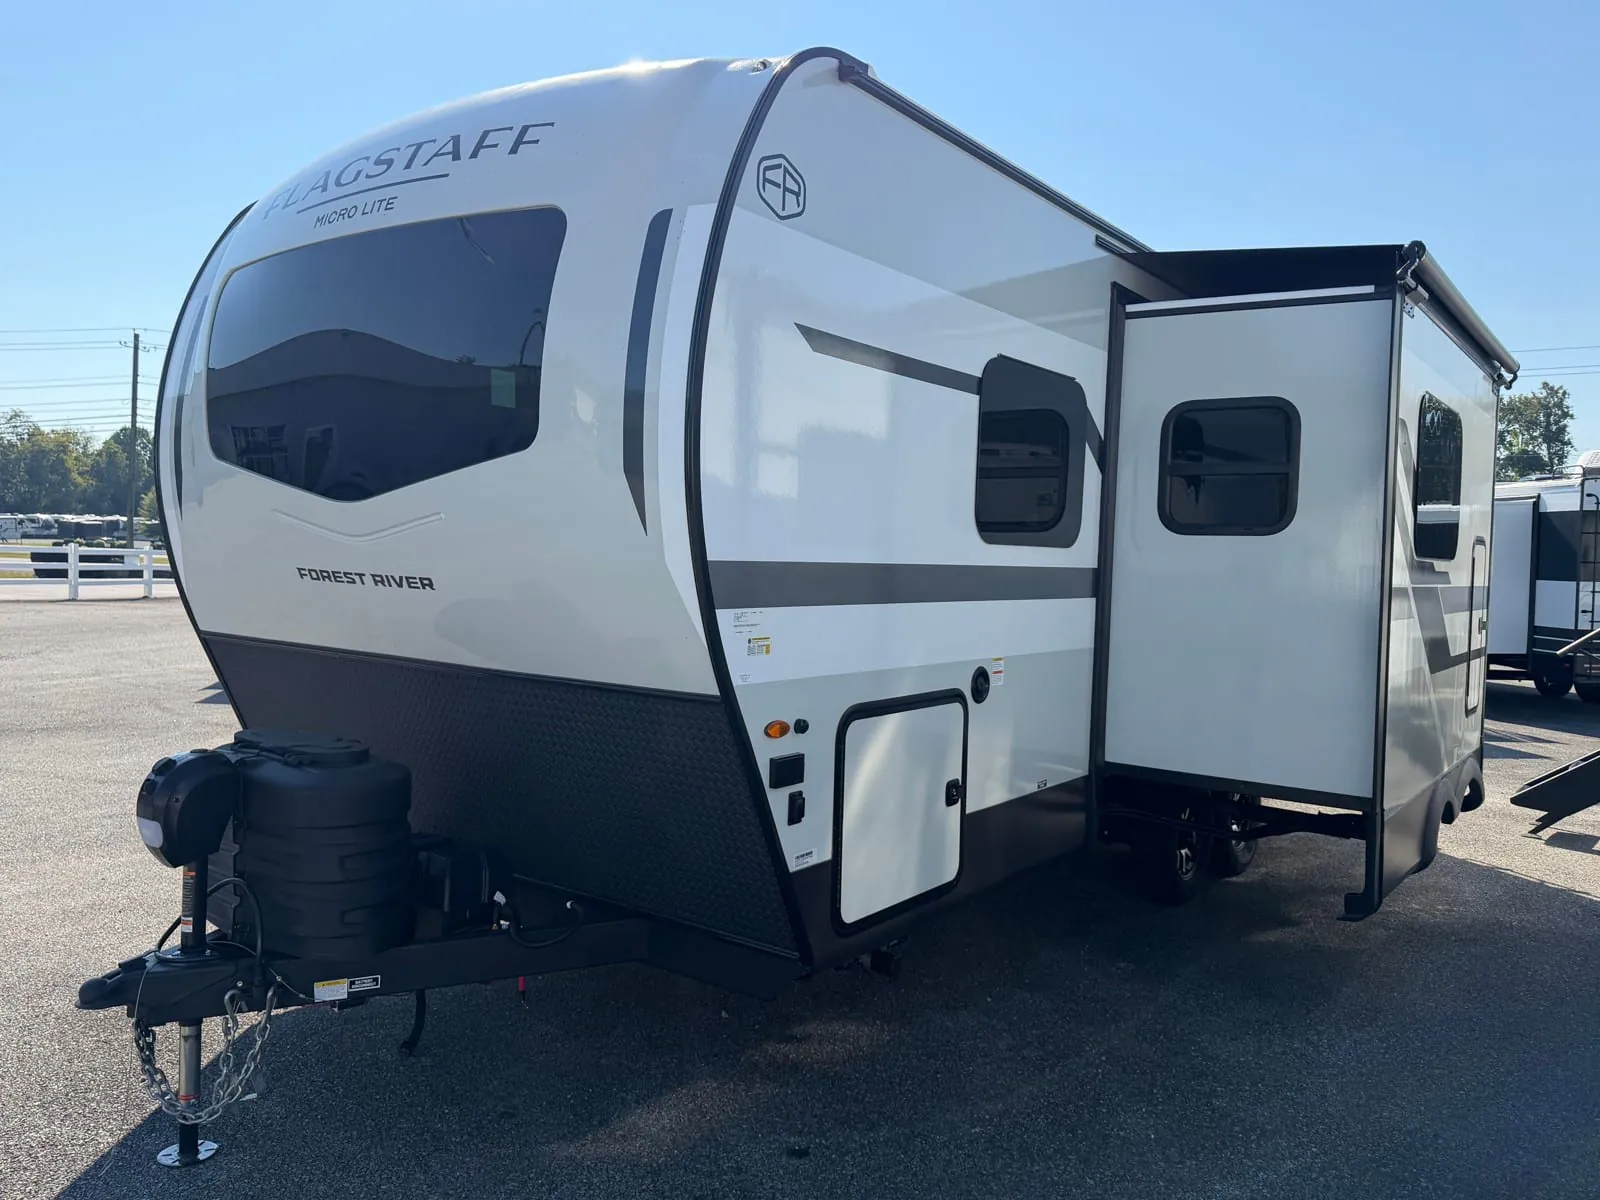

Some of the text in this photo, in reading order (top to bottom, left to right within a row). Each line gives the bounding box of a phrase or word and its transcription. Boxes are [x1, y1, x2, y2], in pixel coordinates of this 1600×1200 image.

[263, 122, 555, 219] FLAGSTAFF
[314, 196, 399, 228] MICRO LITE
[296, 567, 436, 591] FOREST RIVER
